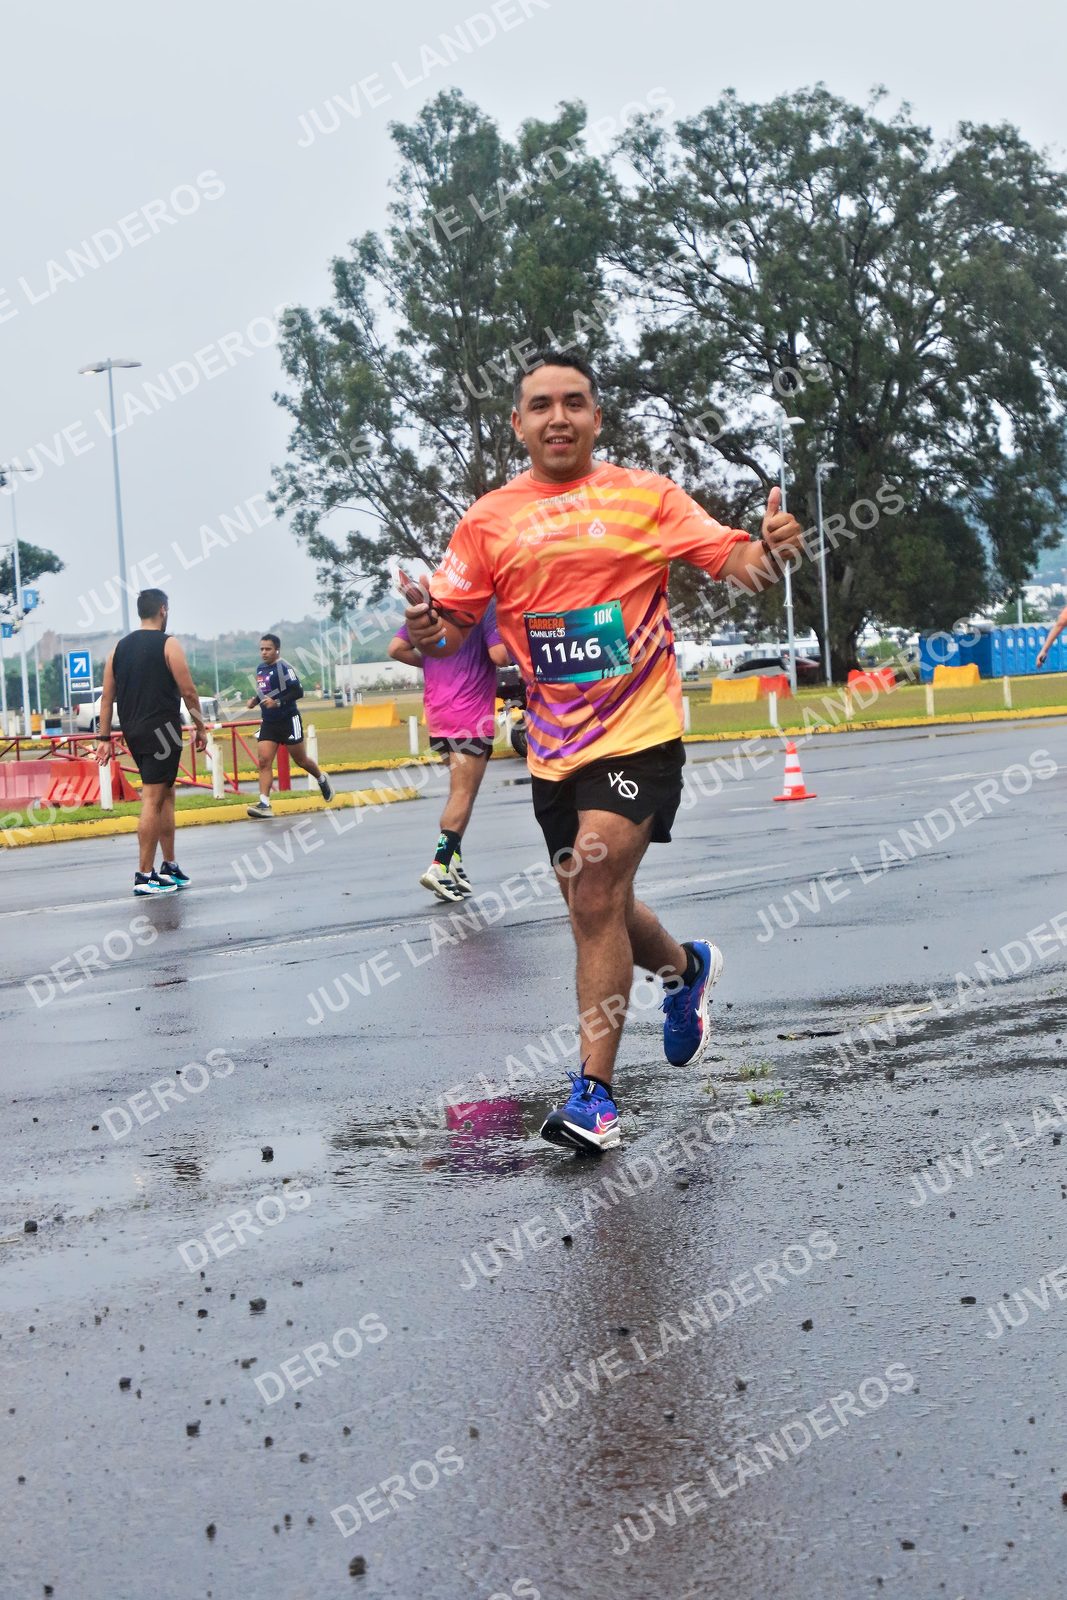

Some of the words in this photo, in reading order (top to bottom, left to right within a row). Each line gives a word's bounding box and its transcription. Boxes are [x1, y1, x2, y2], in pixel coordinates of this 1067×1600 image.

[528, 617, 565, 630] CARRERA
[593, 608, 613, 626] 10K
[530, 630, 557, 638] OMNILIFE
[541, 637, 602, 663] 1146
